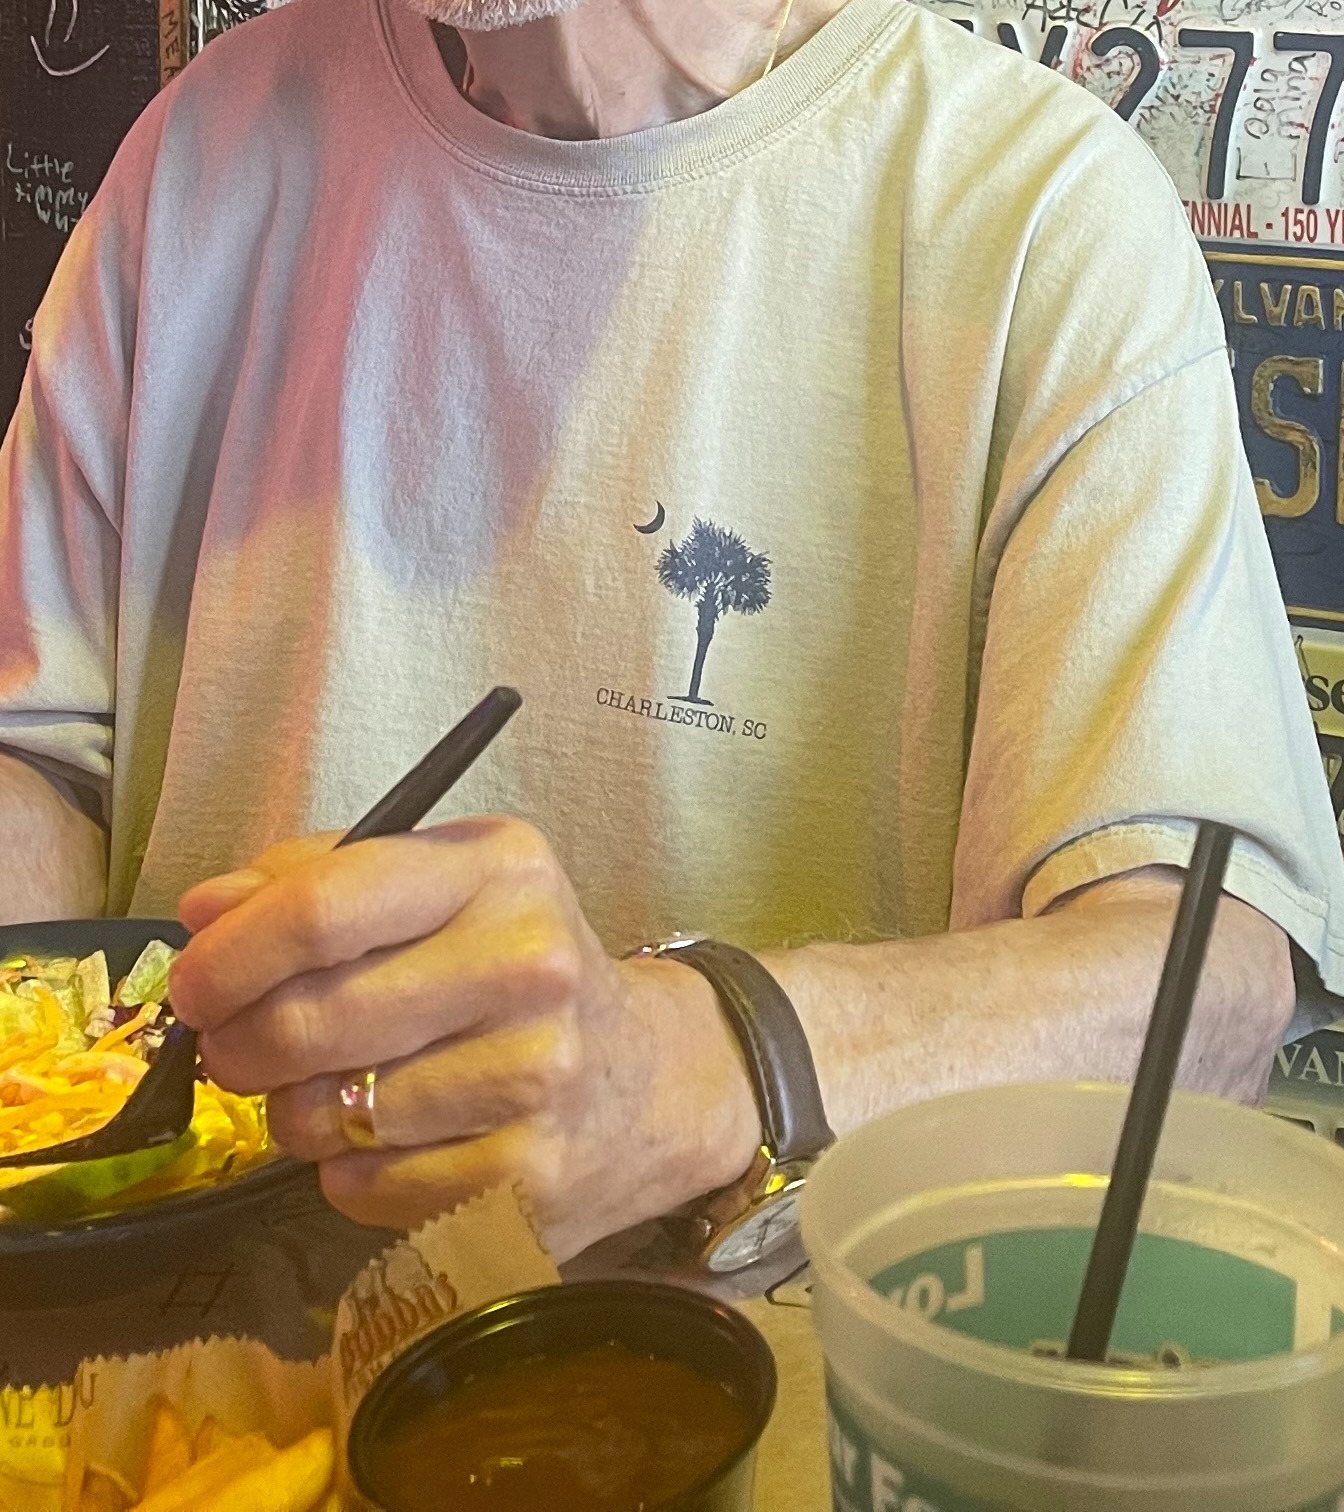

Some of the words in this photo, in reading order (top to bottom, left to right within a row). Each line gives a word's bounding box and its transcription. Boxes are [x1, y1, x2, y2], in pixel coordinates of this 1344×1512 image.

[1280, 206, 1318, 246] 150
[596, 687, 736, 737] CHARLESTON,
[741, 718, 768, 740] SC
